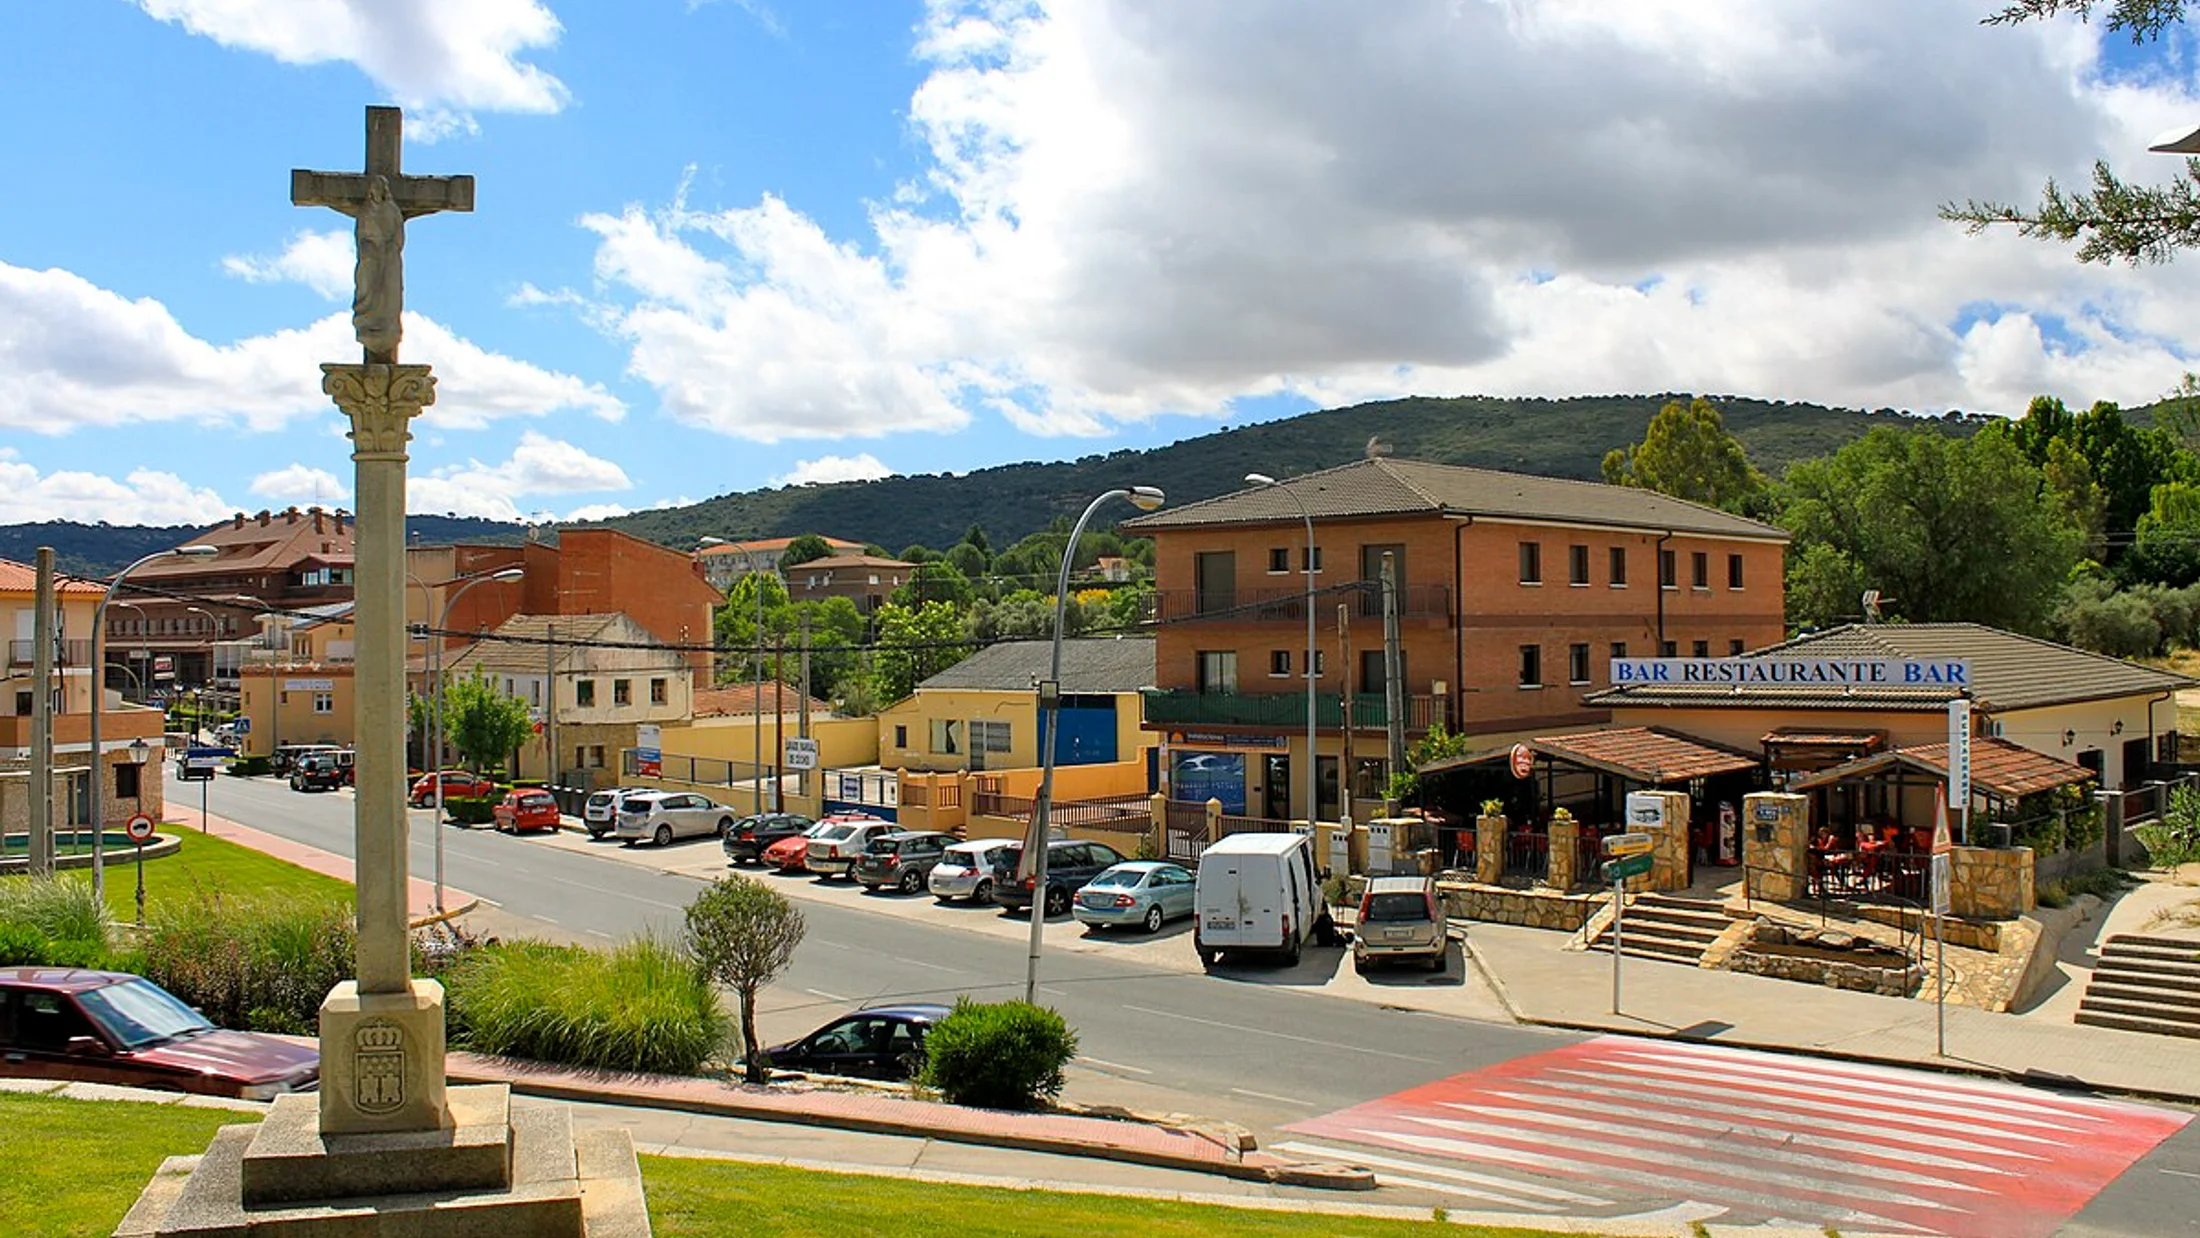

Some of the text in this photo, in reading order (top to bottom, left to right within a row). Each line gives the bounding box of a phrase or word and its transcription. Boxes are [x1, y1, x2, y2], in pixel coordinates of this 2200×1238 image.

[1618, 662, 1966, 683] BAR RESTAURANTE BAR
